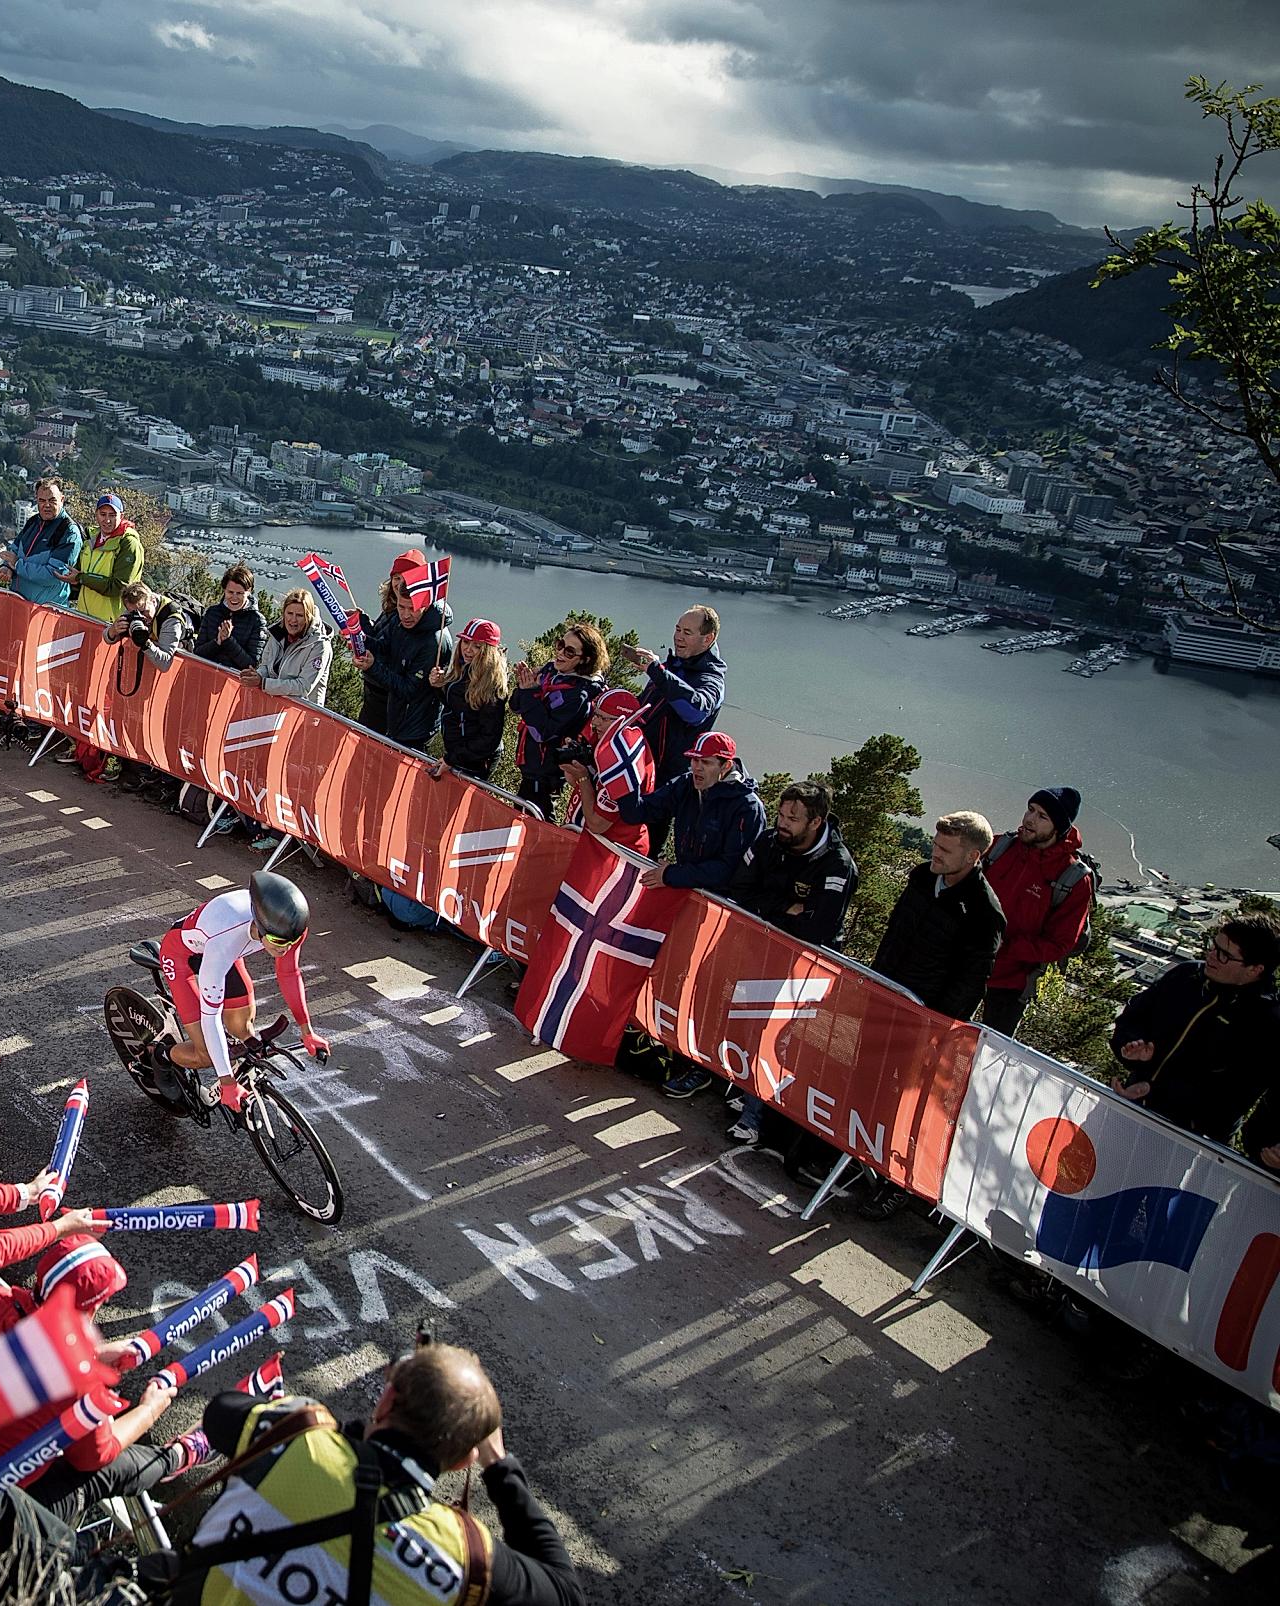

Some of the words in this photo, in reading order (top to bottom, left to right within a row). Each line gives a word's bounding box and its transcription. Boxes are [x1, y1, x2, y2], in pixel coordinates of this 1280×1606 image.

[179, 745, 325, 845] FLØYEN
[387, 857, 531, 962] FLØYE
[161, 955, 176, 981] SGP
[654, 998, 886, 1164] FLØYEN
